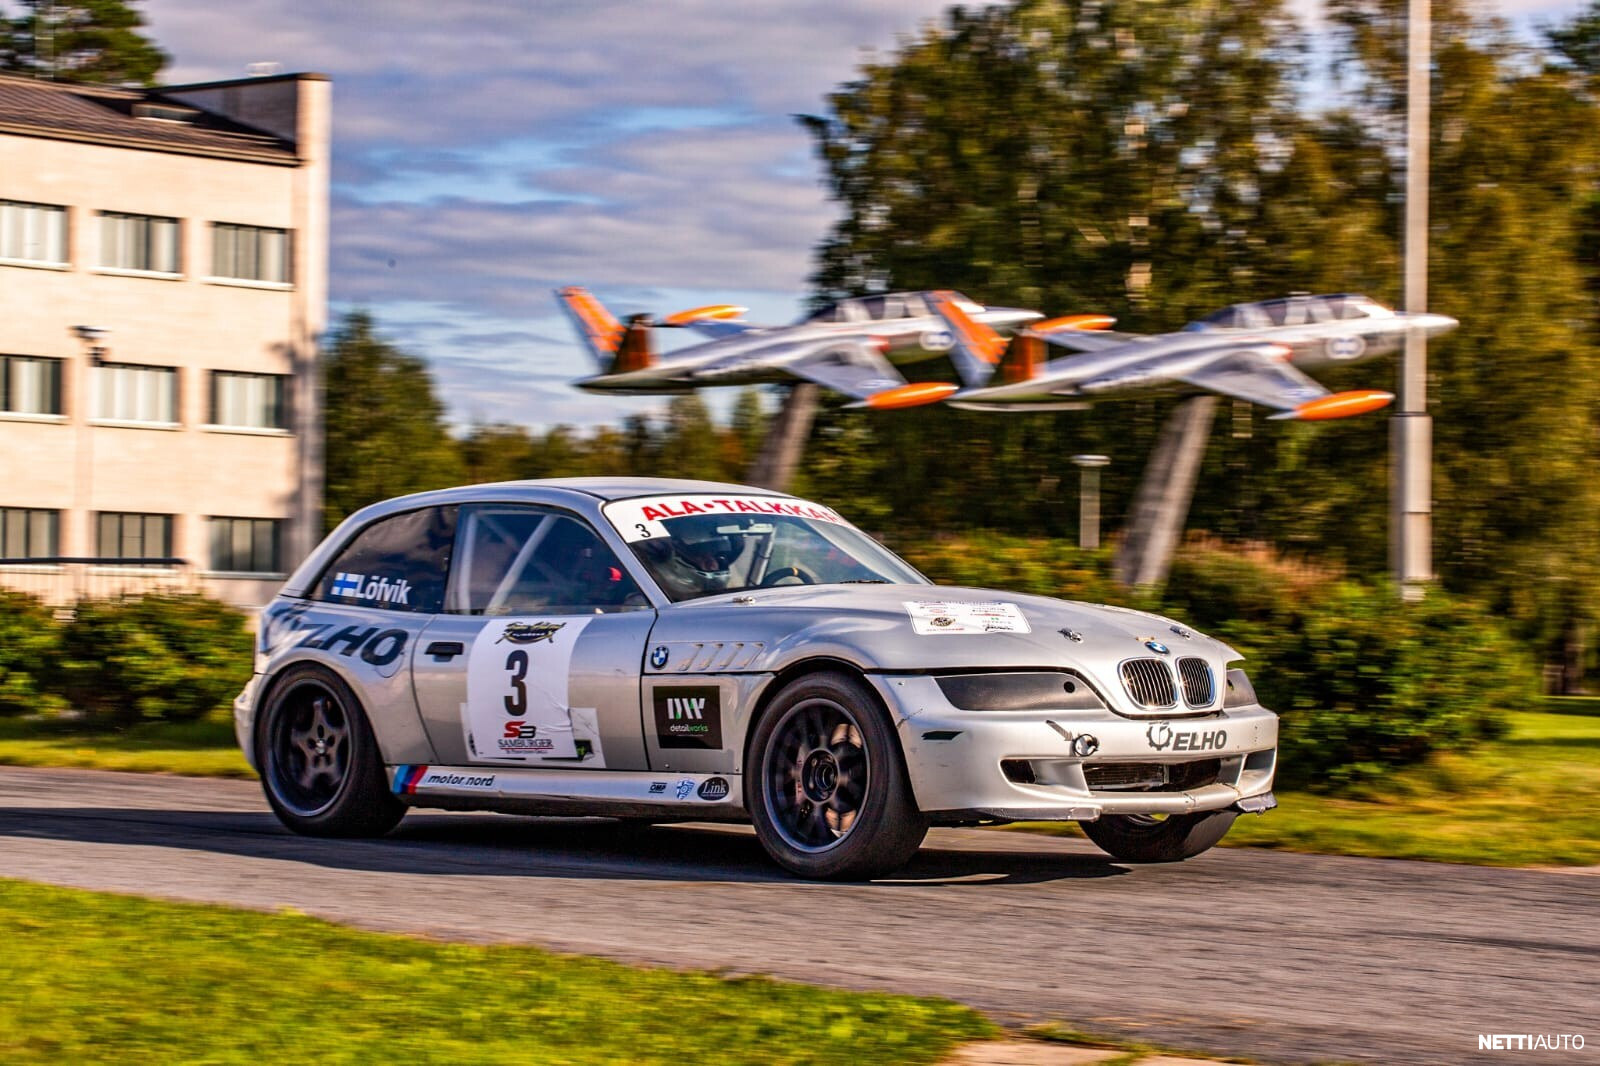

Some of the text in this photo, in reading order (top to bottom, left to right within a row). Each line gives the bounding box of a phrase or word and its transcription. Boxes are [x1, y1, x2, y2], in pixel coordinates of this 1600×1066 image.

[635, 523, 651, 538] 3
[355, 574, 412, 604] Löfvik
[504, 650, 529, 717] 3
[497, 738, 555, 748] SAMBURGER
[1172, 729, 1227, 751] ELHO
[427, 774, 496, 787] motor nord
[702, 780, 727, 794] Link
